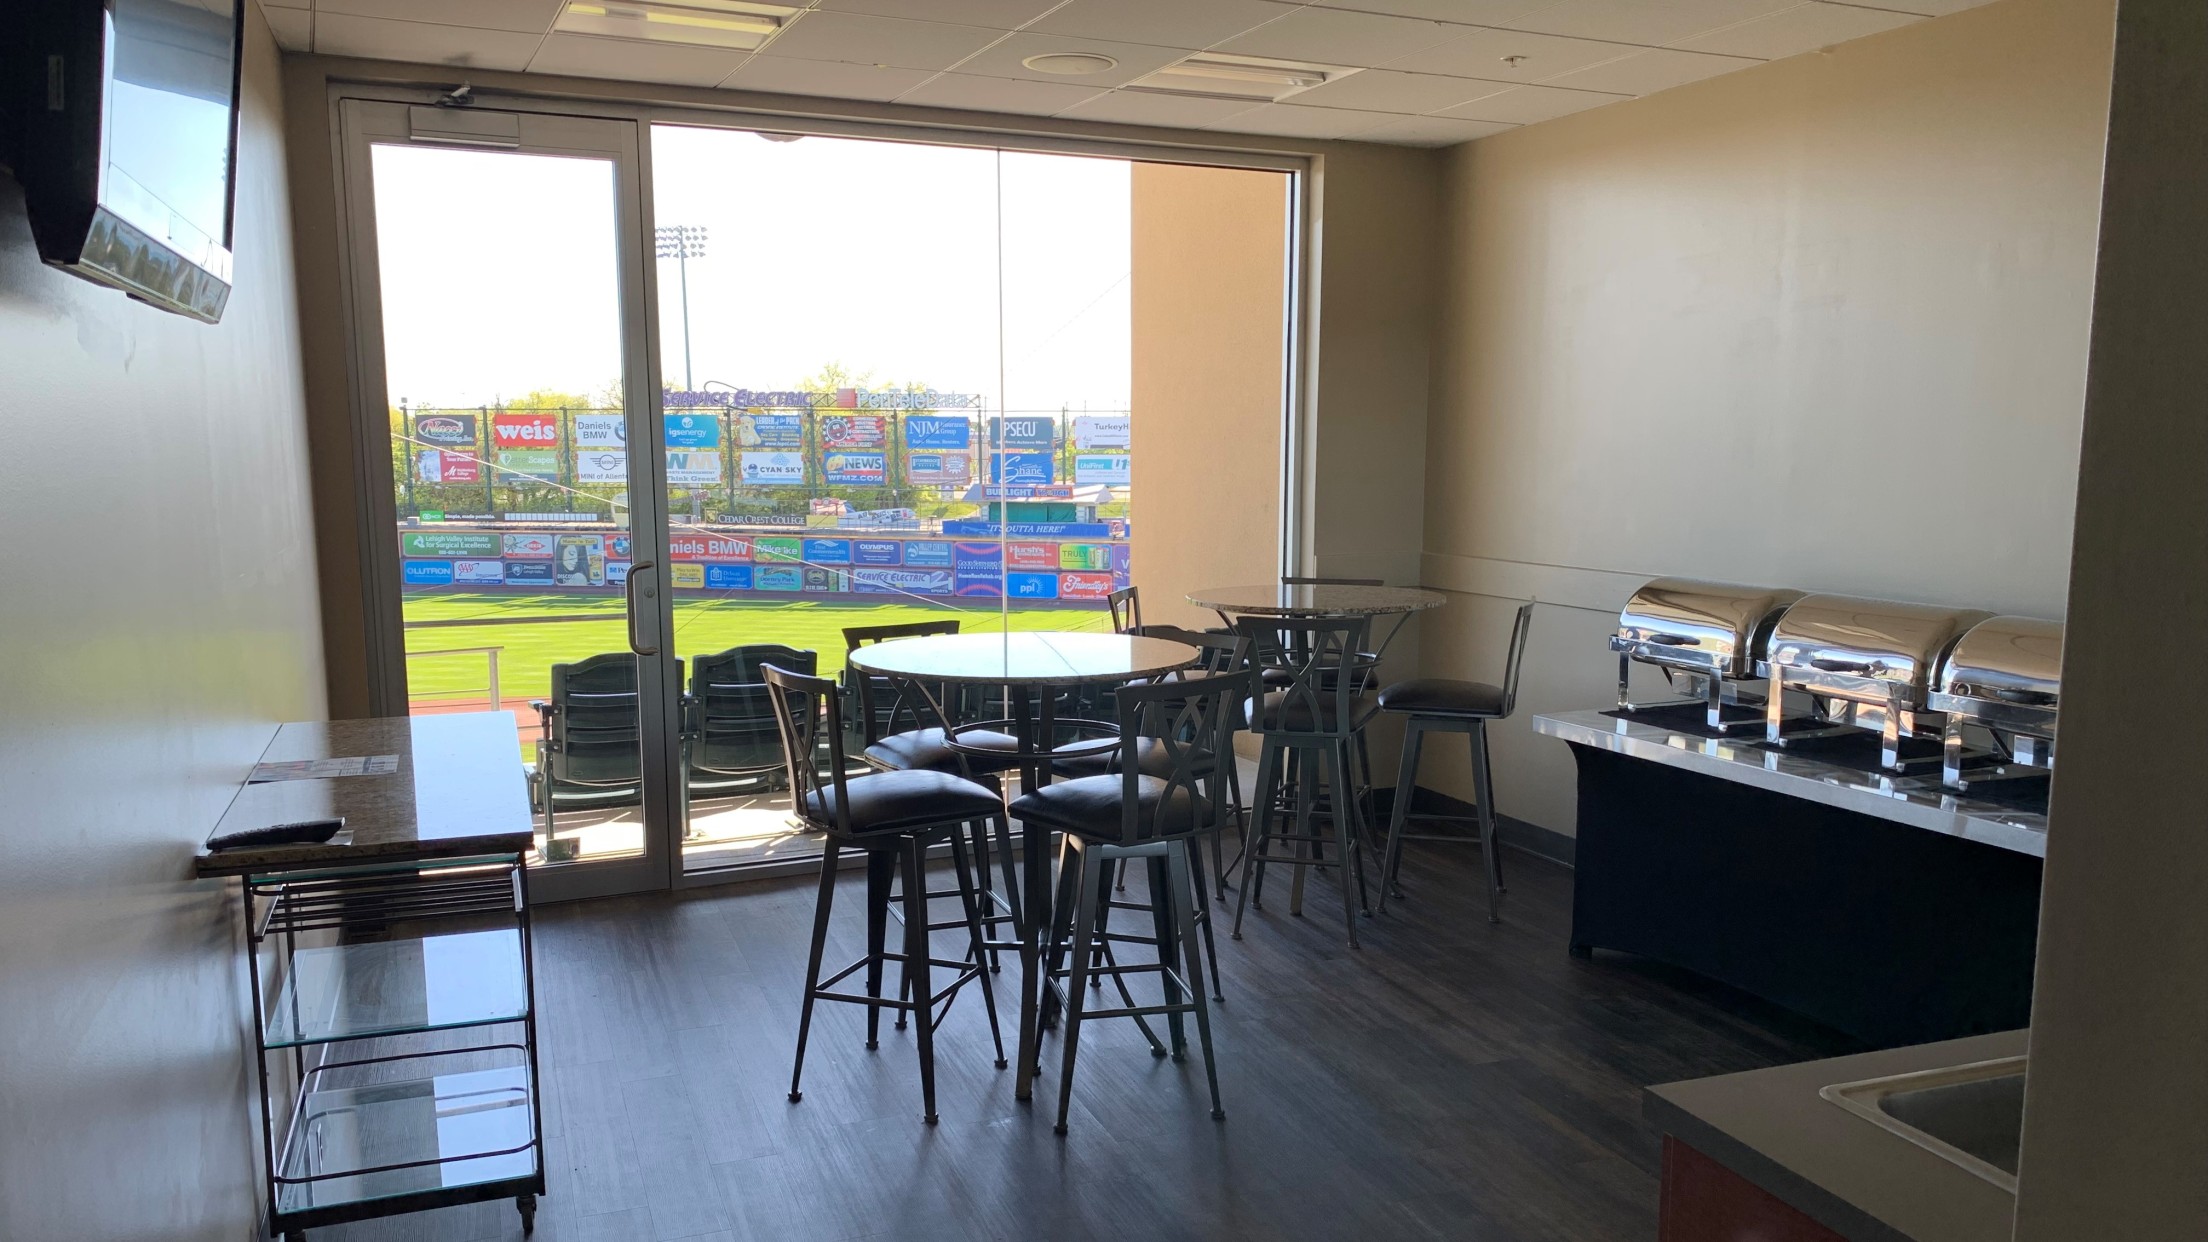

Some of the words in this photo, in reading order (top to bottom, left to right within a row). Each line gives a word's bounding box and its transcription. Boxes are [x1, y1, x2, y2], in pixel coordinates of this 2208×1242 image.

[663, 389, 729, 407] SERVICE
[734, 389, 813, 407] ELECTRIC
[496, 419, 555, 440] weis
[577, 421, 612, 430] Daniels
[908, 420, 940, 438] NJM
[1004, 421, 1036, 437] PSECU
[583, 431, 608, 439] BMW
[845, 457, 882, 470] NEWS
[828, 474, 883, 482] WFMZ.COM
[1006, 488, 1033, 496] LIGHT
[718, 514, 745, 525] CEDAR
[744, 514, 775, 526] CREST
[774, 515, 806, 526] COLLEGE
[1006, 525, 1034, 533] OUTTA
[425, 535, 446, 543] Lehigh
[445, 535, 464, 543] Valley
[435, 542, 460, 550] Surgical
[708, 540, 749, 555] BMW
[859, 543, 895, 551] OLYMPUS
[1062, 550, 1087, 558] TRULY
[856, 571, 890, 582] SERVICE
[890, 572, 926, 583] ELECTRIC
[1020, 583, 1035, 594] ppl
[1062, 575, 1109, 594] Friendly's
